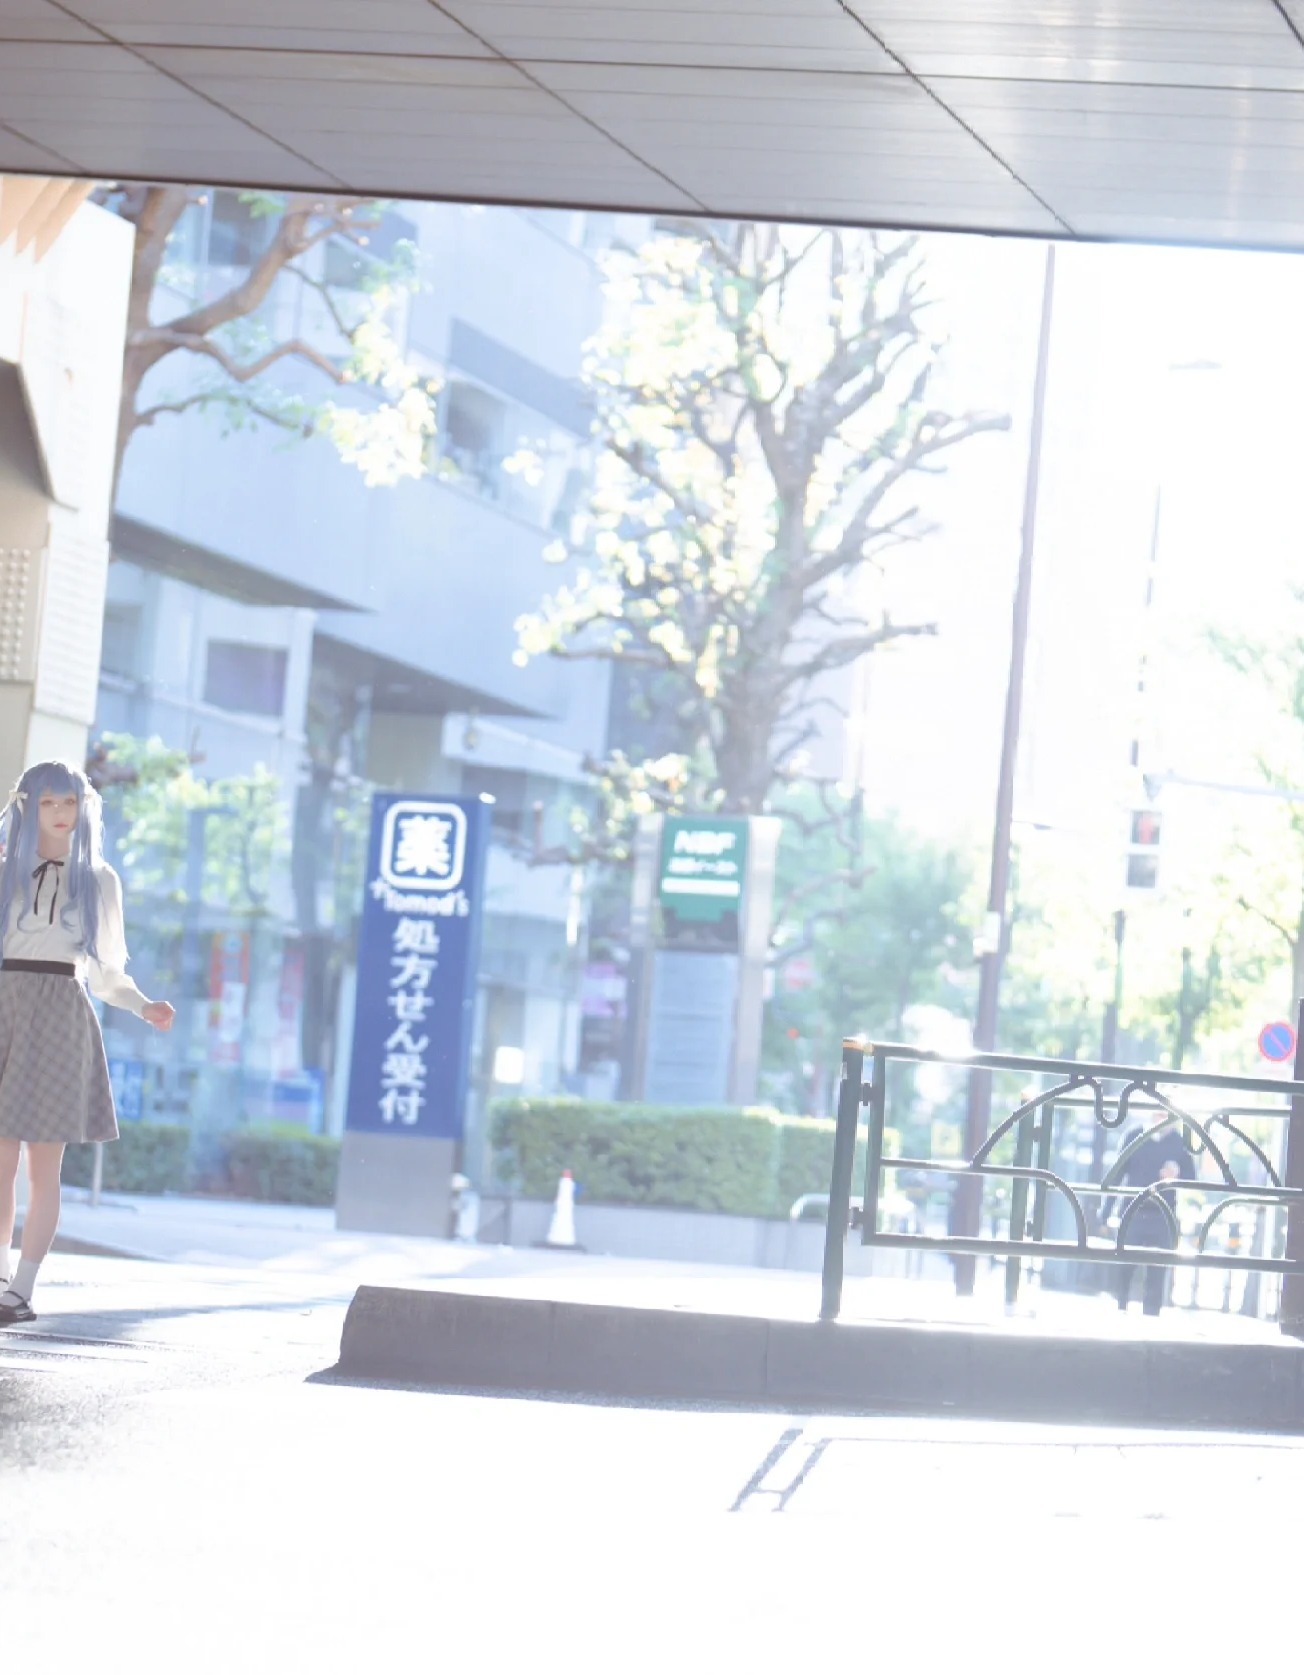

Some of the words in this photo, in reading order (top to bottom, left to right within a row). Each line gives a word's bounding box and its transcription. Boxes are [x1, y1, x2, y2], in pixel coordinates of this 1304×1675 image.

[395, 815, 451, 876] 薬
[369, 877, 470, 917] Tomod's
[378, 917, 440, 1125] 処方せん受付
